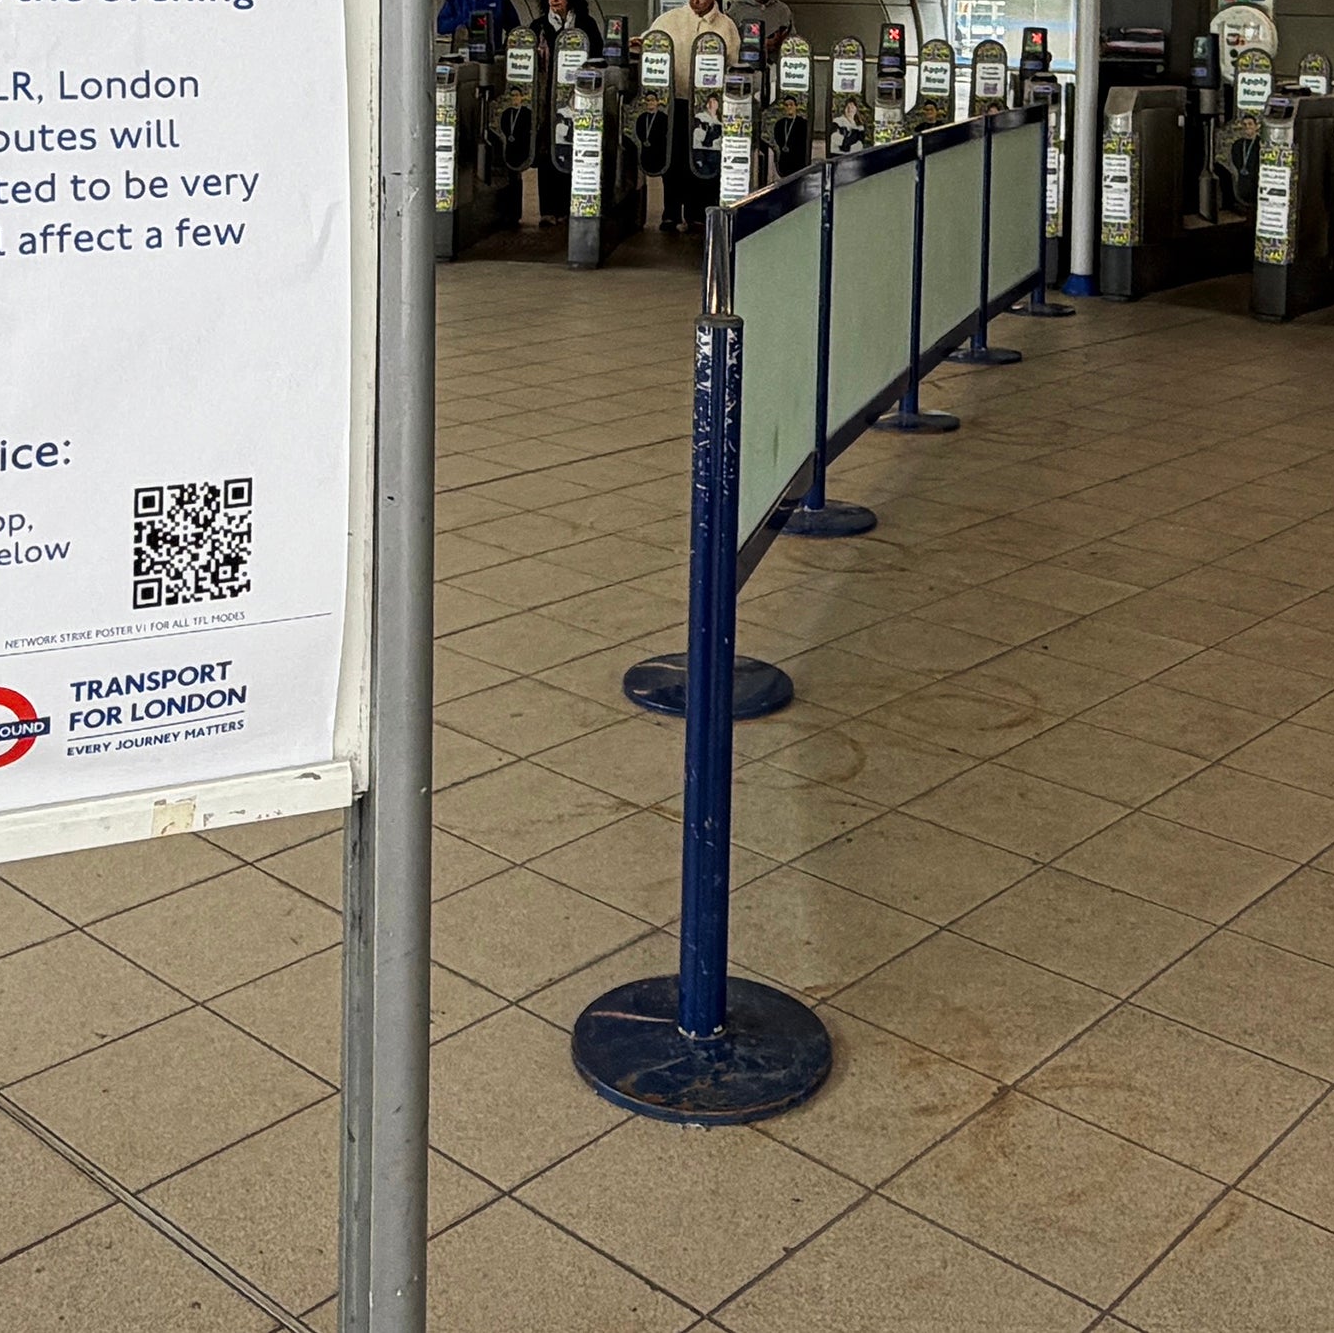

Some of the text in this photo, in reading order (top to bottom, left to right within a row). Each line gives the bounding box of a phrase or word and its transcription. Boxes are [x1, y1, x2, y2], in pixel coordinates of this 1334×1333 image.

[60, 70, 198, 99] London
[70, 660, 233, 702] TRANSPORT
[69, 685, 248, 732] FOR LONDON
[67, 719, 245, 756] EVERY JOURNEY MATTERS
